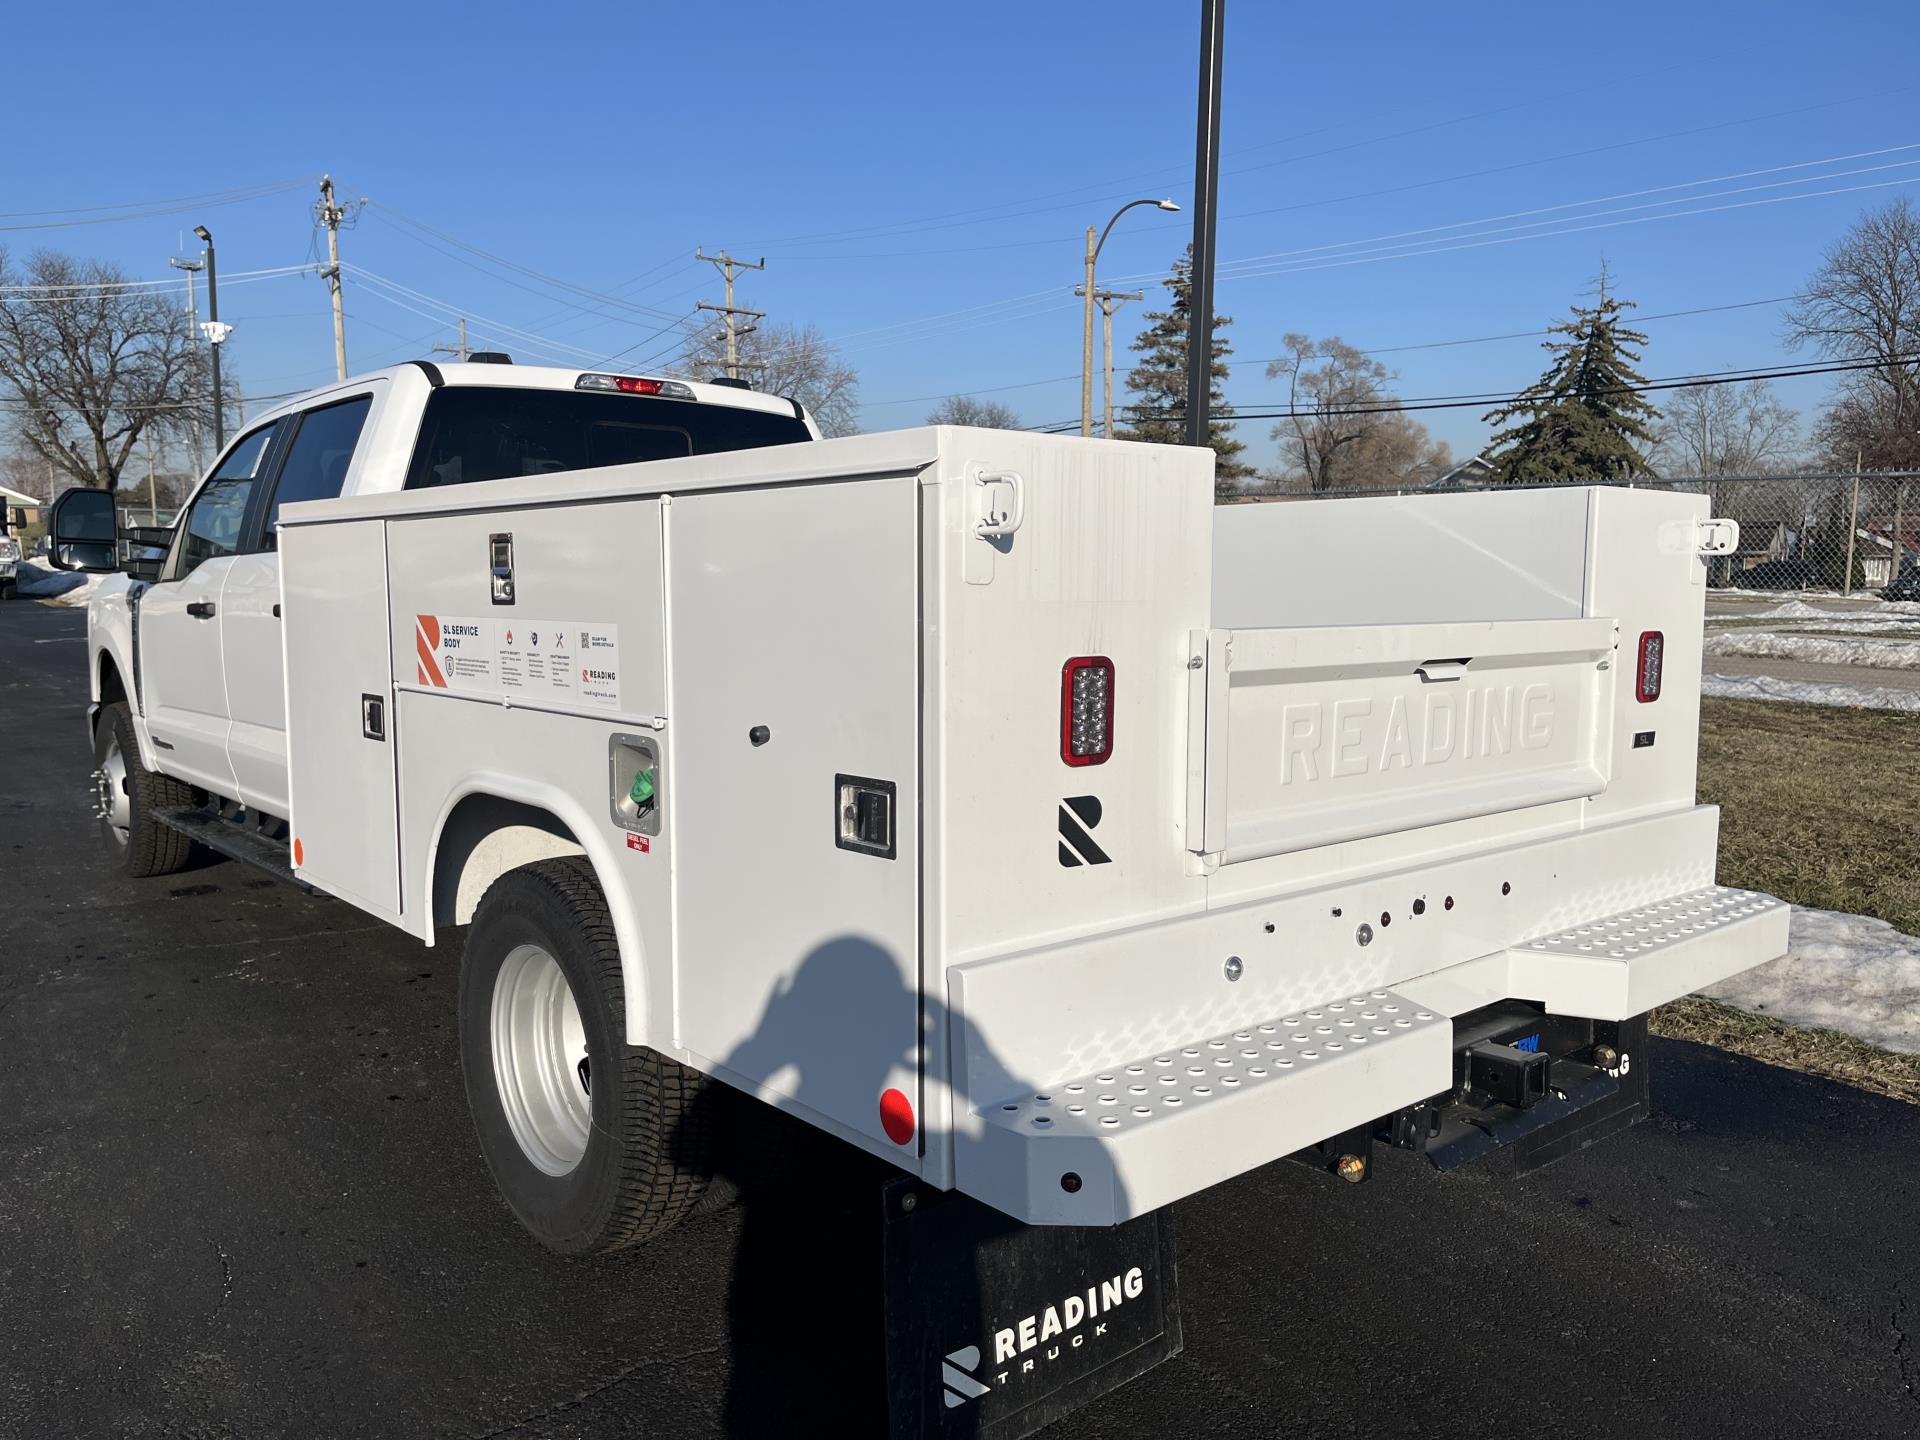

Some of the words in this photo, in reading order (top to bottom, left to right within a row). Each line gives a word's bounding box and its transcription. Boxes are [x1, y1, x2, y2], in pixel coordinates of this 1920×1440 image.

[443, 625, 451, 635] SL
[451, 626, 479, 636] SERVICE
[444, 638, 461, 648] BODY
[590, 670, 616, 681] READING
[1280, 683, 1556, 785] READING
[995, 1266, 1143, 1364] READING
[998, 1322, 1107, 1384] TRUCK
